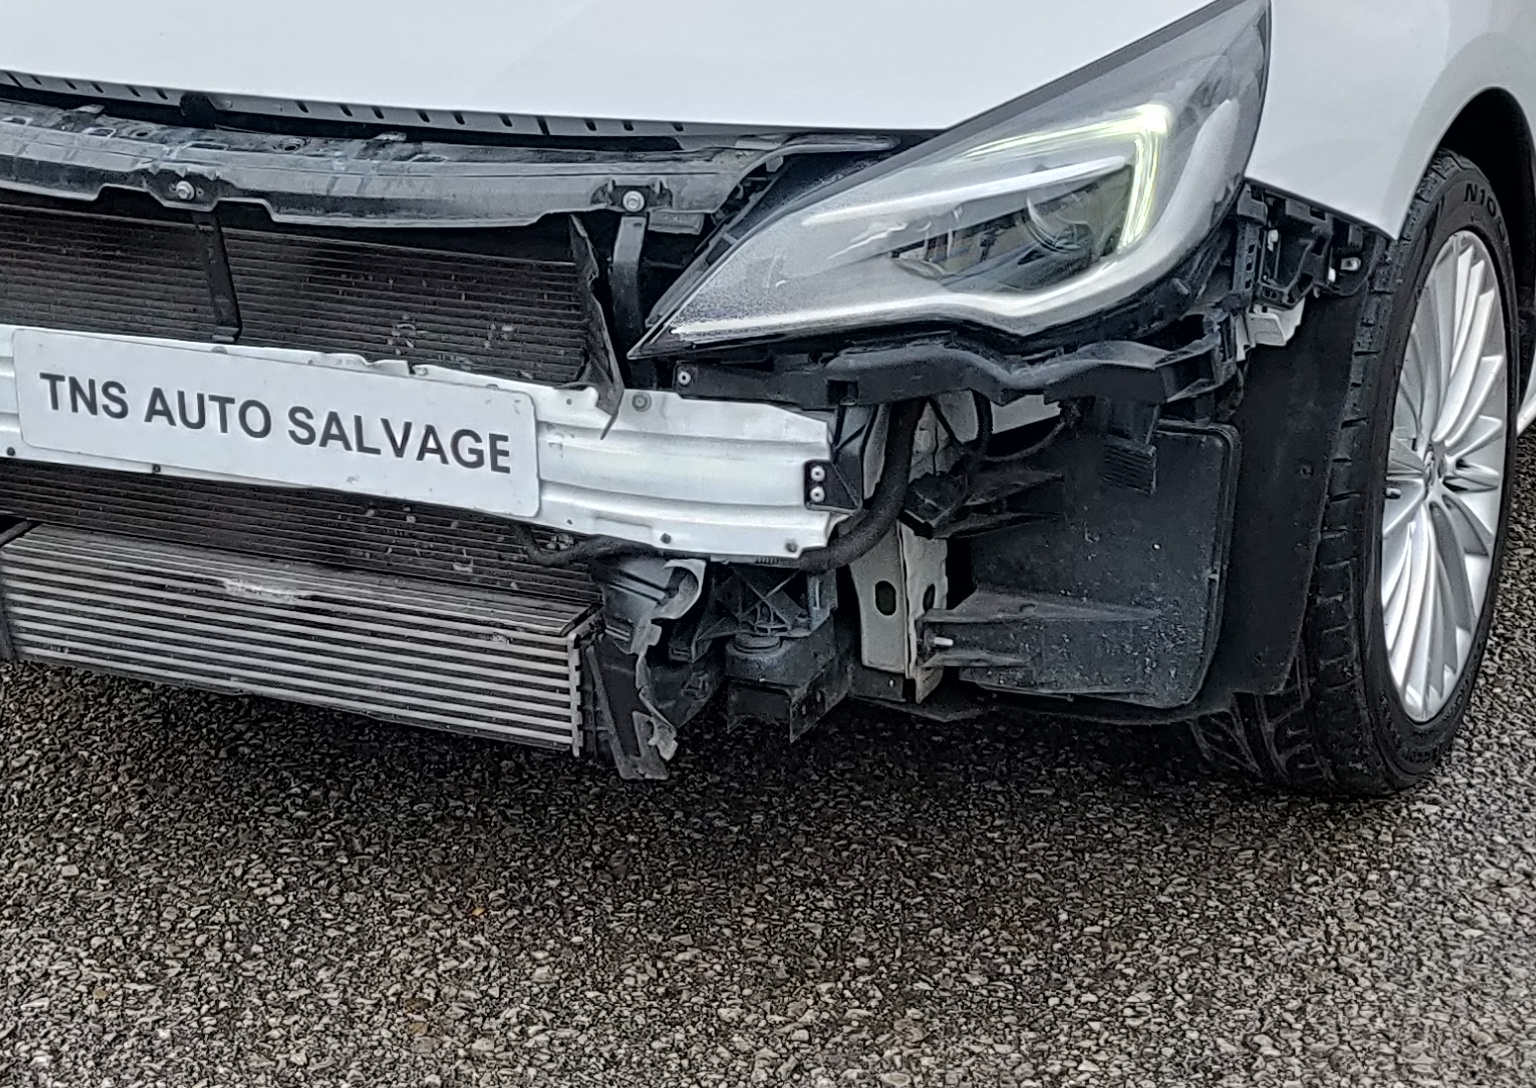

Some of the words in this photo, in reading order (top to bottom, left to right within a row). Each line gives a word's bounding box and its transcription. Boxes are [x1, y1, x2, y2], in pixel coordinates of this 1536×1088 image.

[38, 372, 128, 420] TNS
[144, 387, 273, 440] AUTO
[287, 405, 511, 475] SALVAGE
